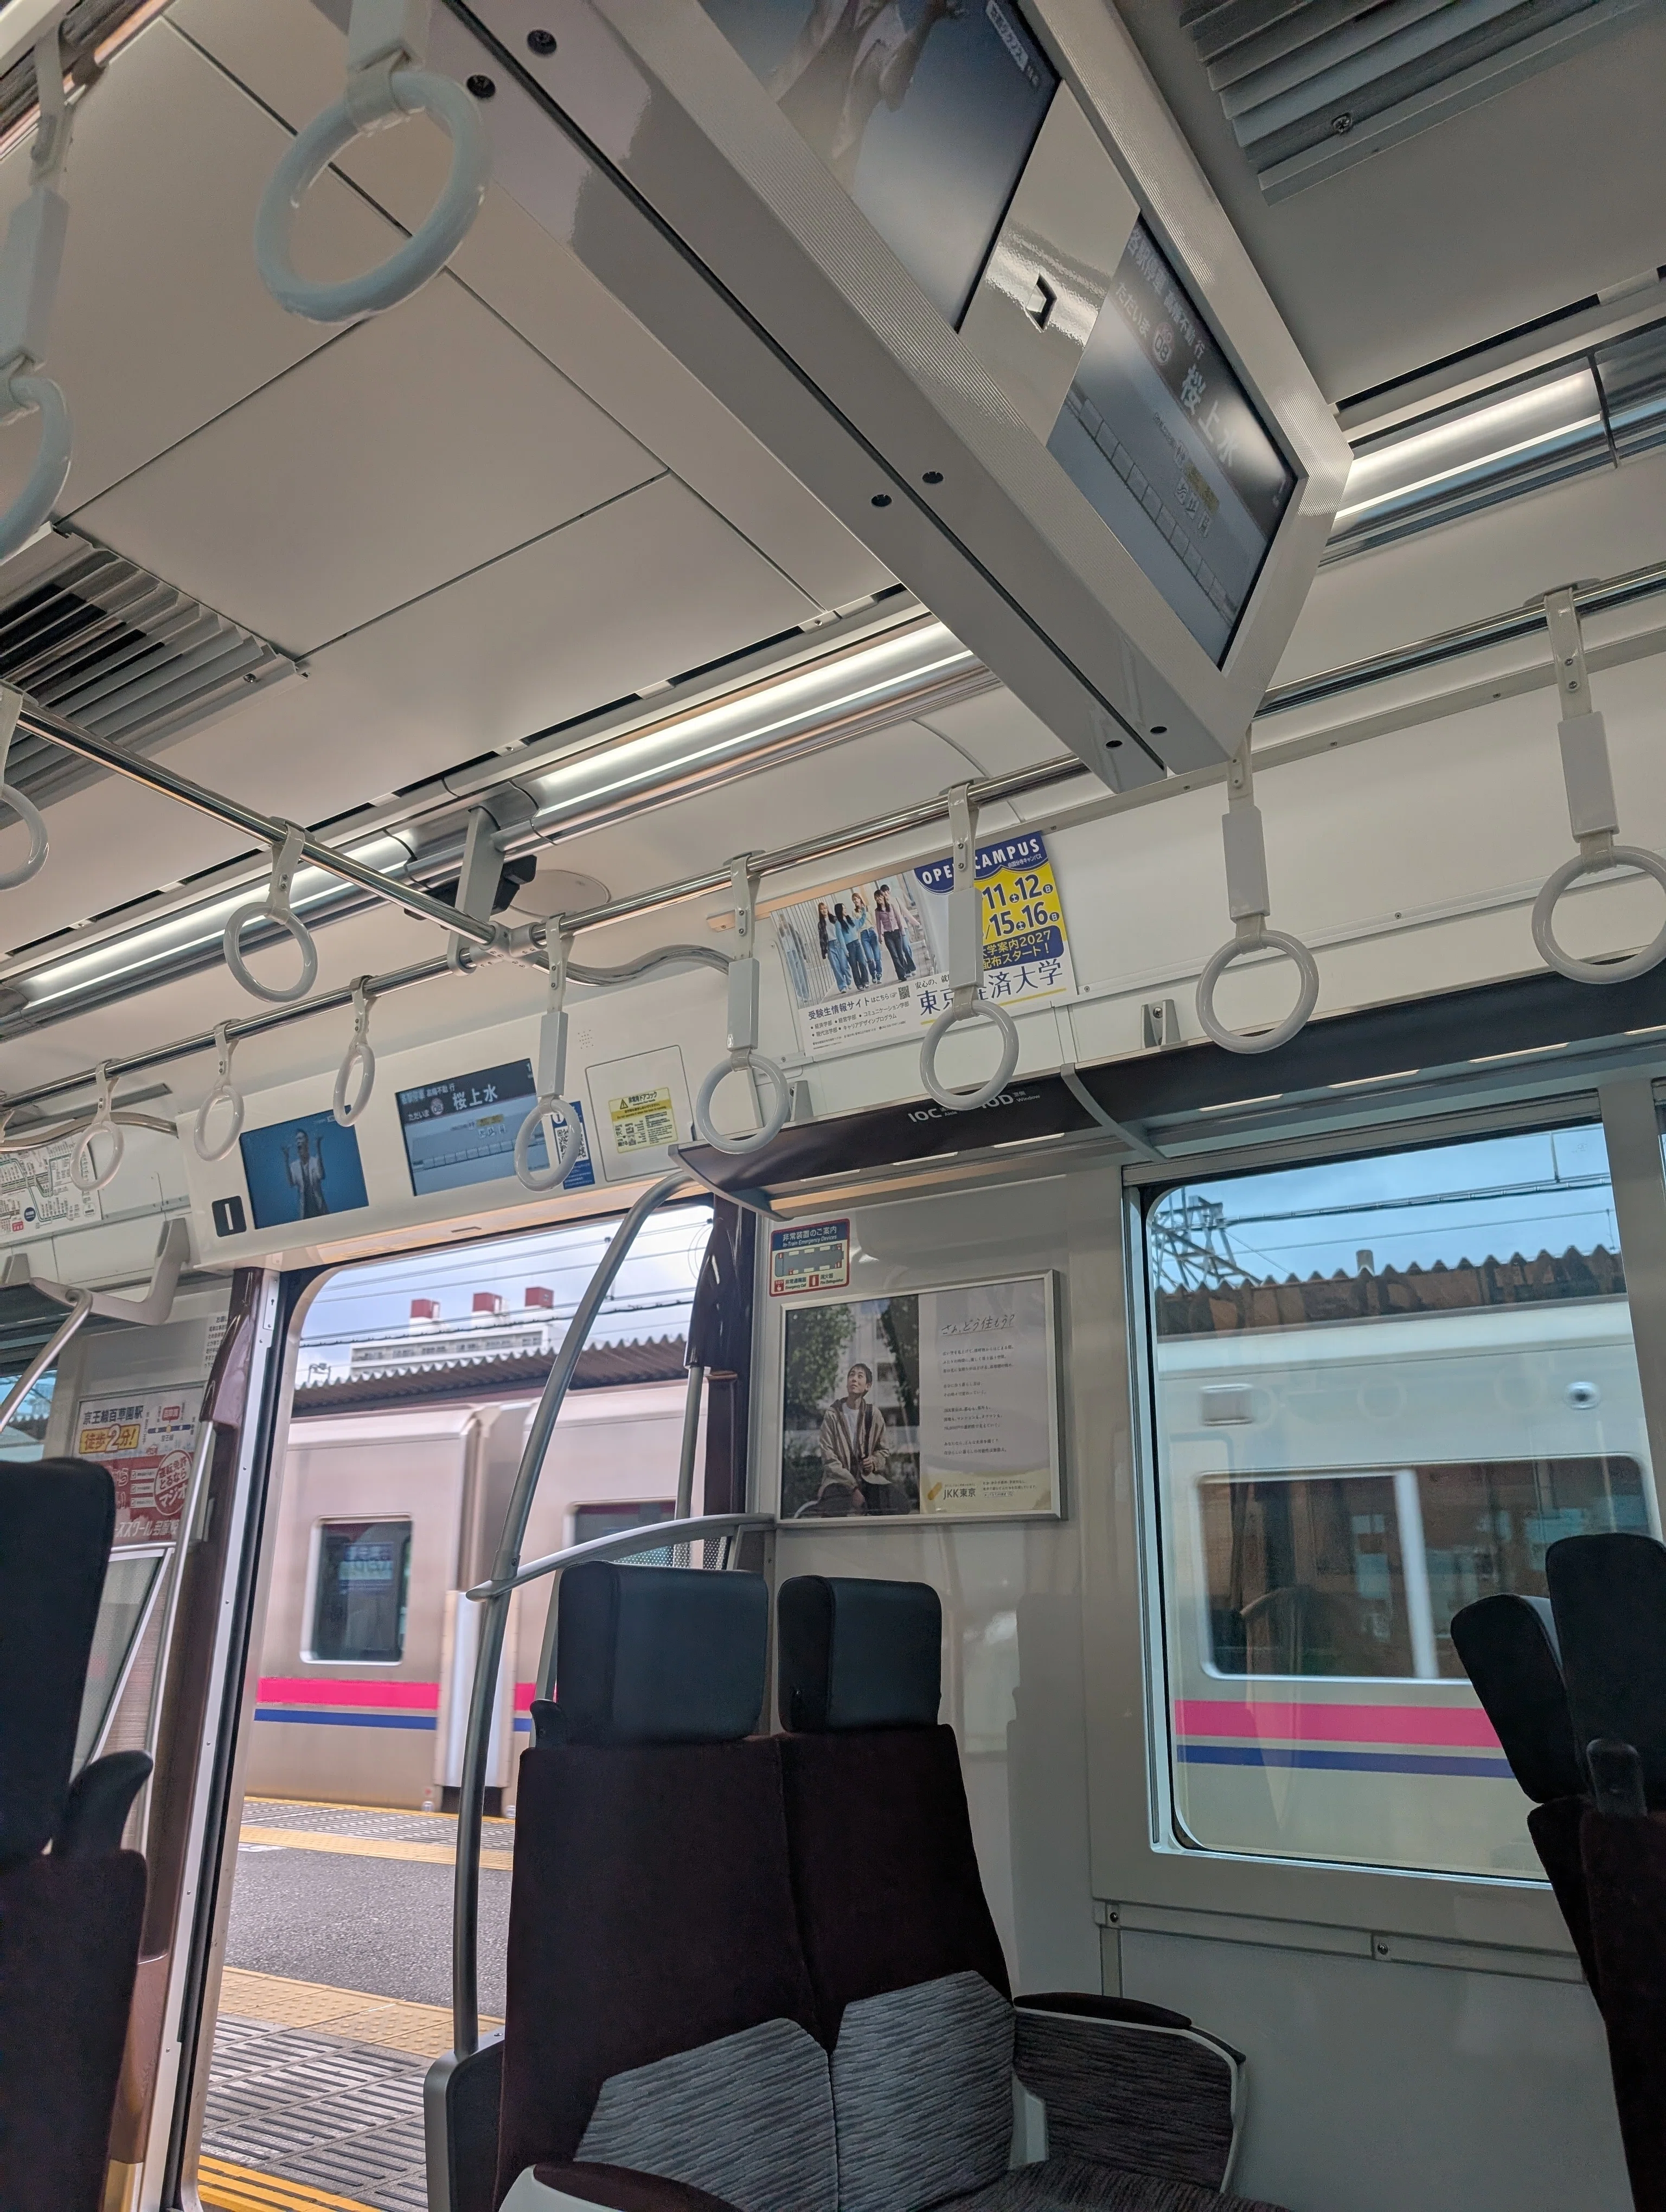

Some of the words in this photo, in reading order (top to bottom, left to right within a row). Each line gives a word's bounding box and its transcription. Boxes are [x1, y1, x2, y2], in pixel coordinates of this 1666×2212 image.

[1155, 334, 1170, 358] 08
[1180, 364, 1238, 467] 桜上水
[922, 864, 954, 884] OPE
[915, 975, 950, 989] 安心の、就
[815, 1020, 832, 1029] 経済学部
[838, 1014, 856, 1024] 経営学部
[863, 1001, 909, 1017] コミュニケーション学部
[816, 1027, 838, 1037] 現代法学部
[843, 1013, 897, 1031] キャリアデザインプログラム
[452, 1084, 498, 1110] 桜上水
[907, 1108, 943, 1122] 10C
[783, 1226, 837, 1242] 非常装置のご案内
[159, 1456, 187, 1478] 運転免許
[160, 1468, 187, 1490] とるなら
[943, 1488, 976, 1500] JKK東京
